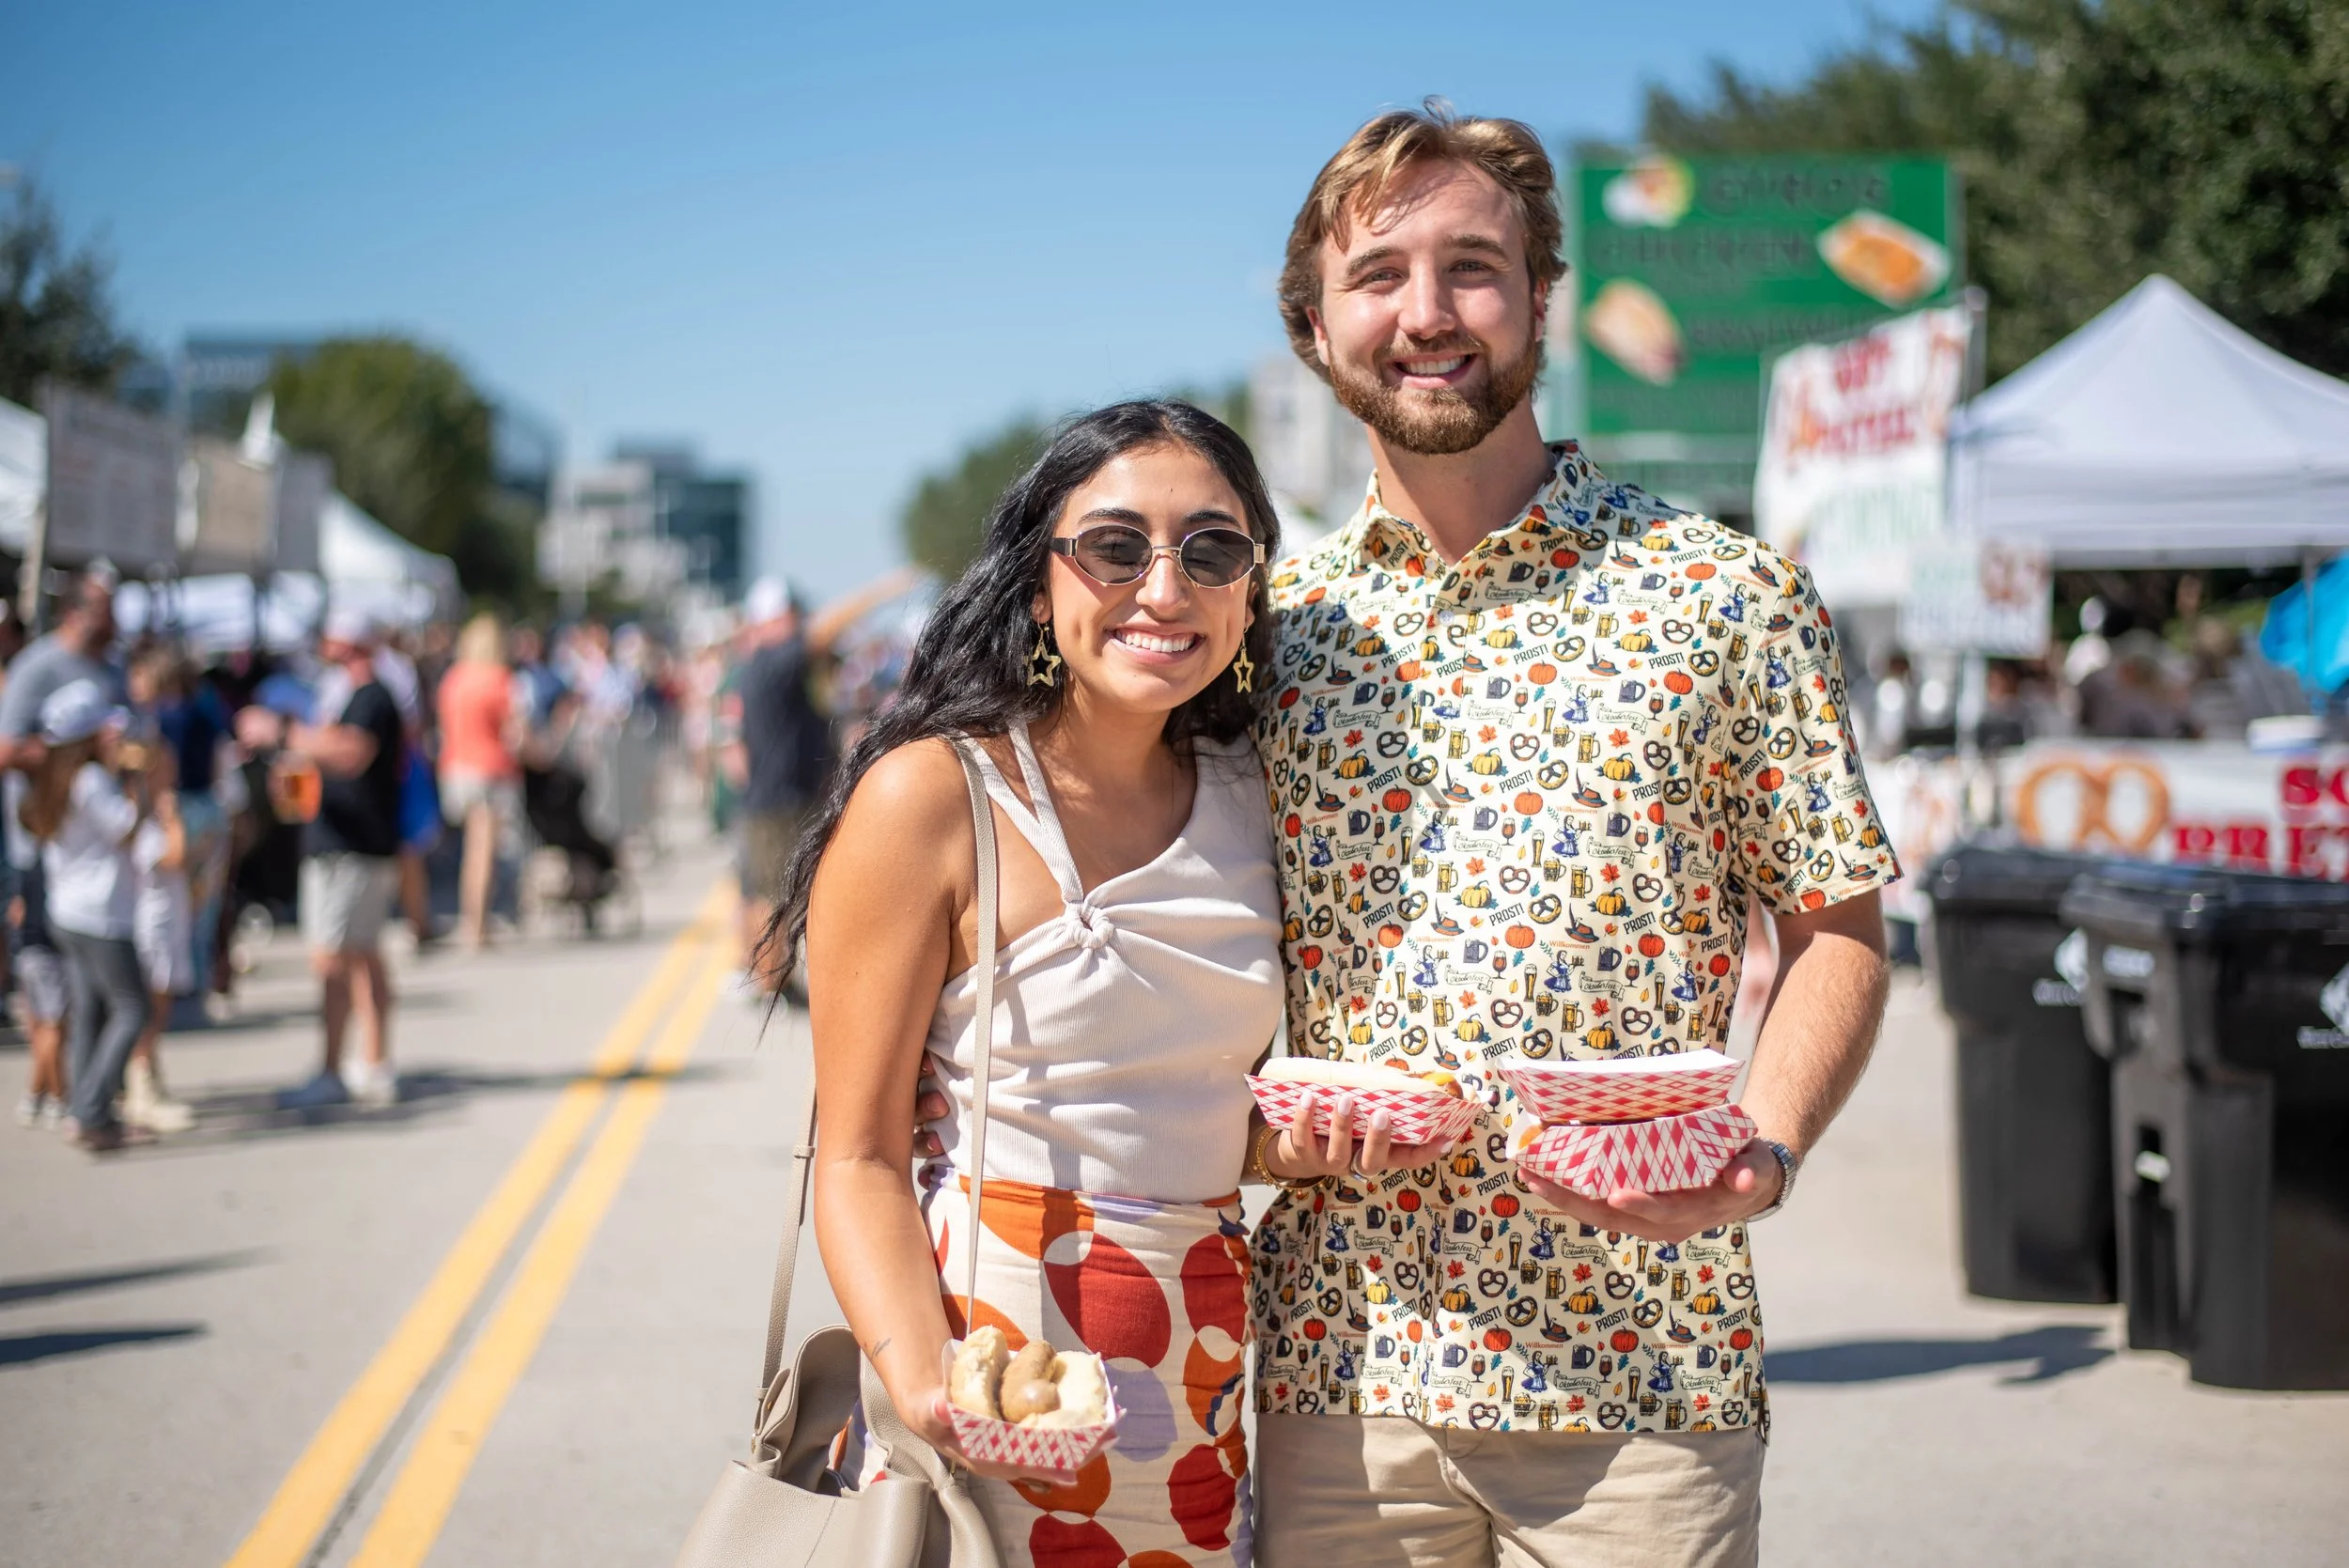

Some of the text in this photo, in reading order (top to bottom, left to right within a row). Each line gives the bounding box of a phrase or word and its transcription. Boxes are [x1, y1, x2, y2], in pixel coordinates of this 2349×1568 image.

[1671, 548, 1707, 564] PROST!
[1381, 644, 1416, 668] PROST!
[1514, 644, 1548, 664] PROST!
[1649, 652, 1685, 669] PROST!
[1738, 750, 1766, 780] PROST!
[1367, 766, 1402, 793] PROST!
[1500, 769, 1533, 793] PROST!
[1305, 812, 1339, 825] Willkommen
[1556, 805, 1598, 815] Willkommen
[1783, 869, 1806, 896] PROST!
[1362, 902, 1394, 928] PROST!
[1489, 903, 1524, 925] PROST!
[1624, 911, 1657, 934] PROST!
[1549, 940, 1590, 950] Willkommen
[1702, 933, 1728, 953] PROST!
[1584, 982, 1616, 990] Oktoberfest
[1370, 1037, 1397, 1062] PROST!
[1482, 1037, 1517, 1060] PROST!
[1380, 1169, 1409, 1192] PROST!
[1477, 1172, 1509, 1196] PROST!
[1566, 1249, 1599, 1257] Oktoberfest
[1290, 1298, 1315, 1321] PROST!
[1392, 1298, 1418, 1322] PROST!
[1469, 1306, 1501, 1330] PROST!
[1595, 1308, 1628, 1332] PROST!
[1717, 1308, 1748, 1331] PROST!
[1559, 1379, 1592, 1388] Oktoberfest
